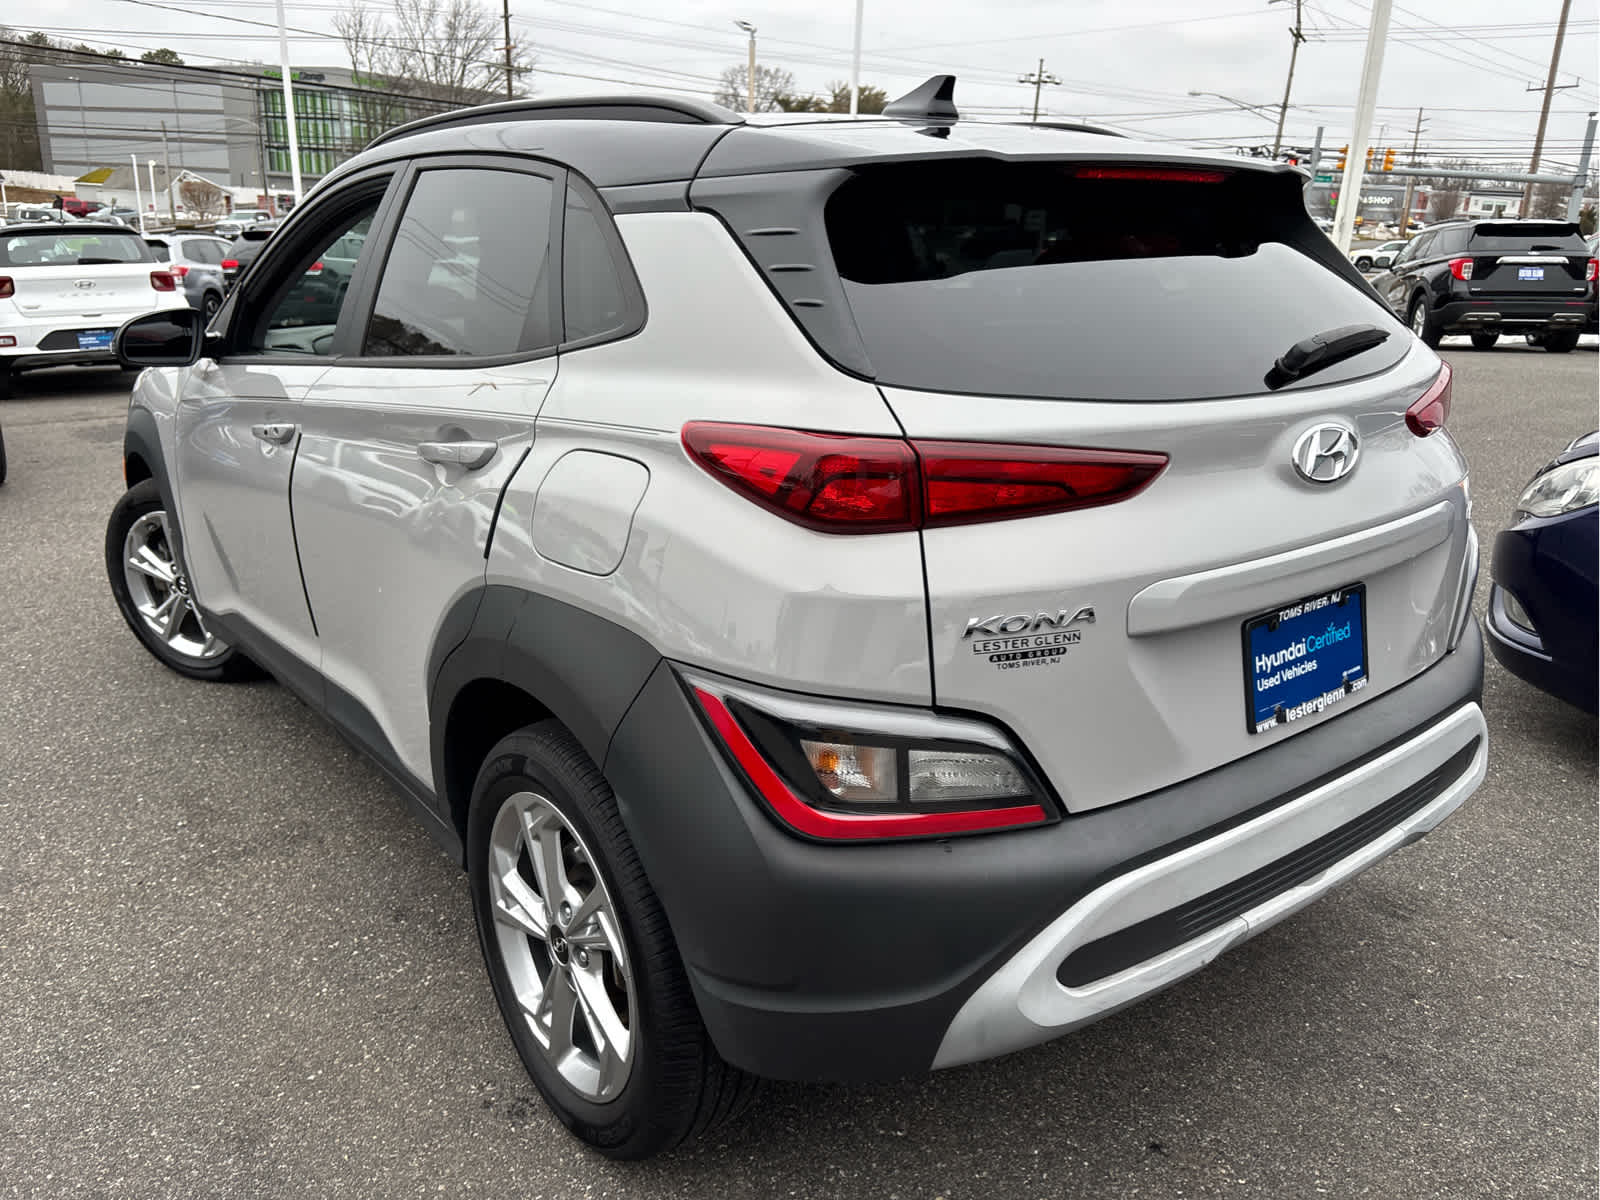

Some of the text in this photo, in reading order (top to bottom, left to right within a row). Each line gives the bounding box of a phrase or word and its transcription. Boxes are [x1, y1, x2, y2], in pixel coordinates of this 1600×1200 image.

[1279, 605, 1302, 622] TOMS
[1331, 591, 1342, 604] NJ
[961, 605, 1097, 640] KONA
[973, 632, 1081, 652] LESTER GLENN
[993, 649, 1064, 662] AUTO GROUP
[1255, 622, 1351, 674] Hyundai Certified
[997, 661, 1021, 670] TOMS
[1023, 659, 1049, 667] RIVER,
[1257, 659, 1317, 691] Used Vehicles
